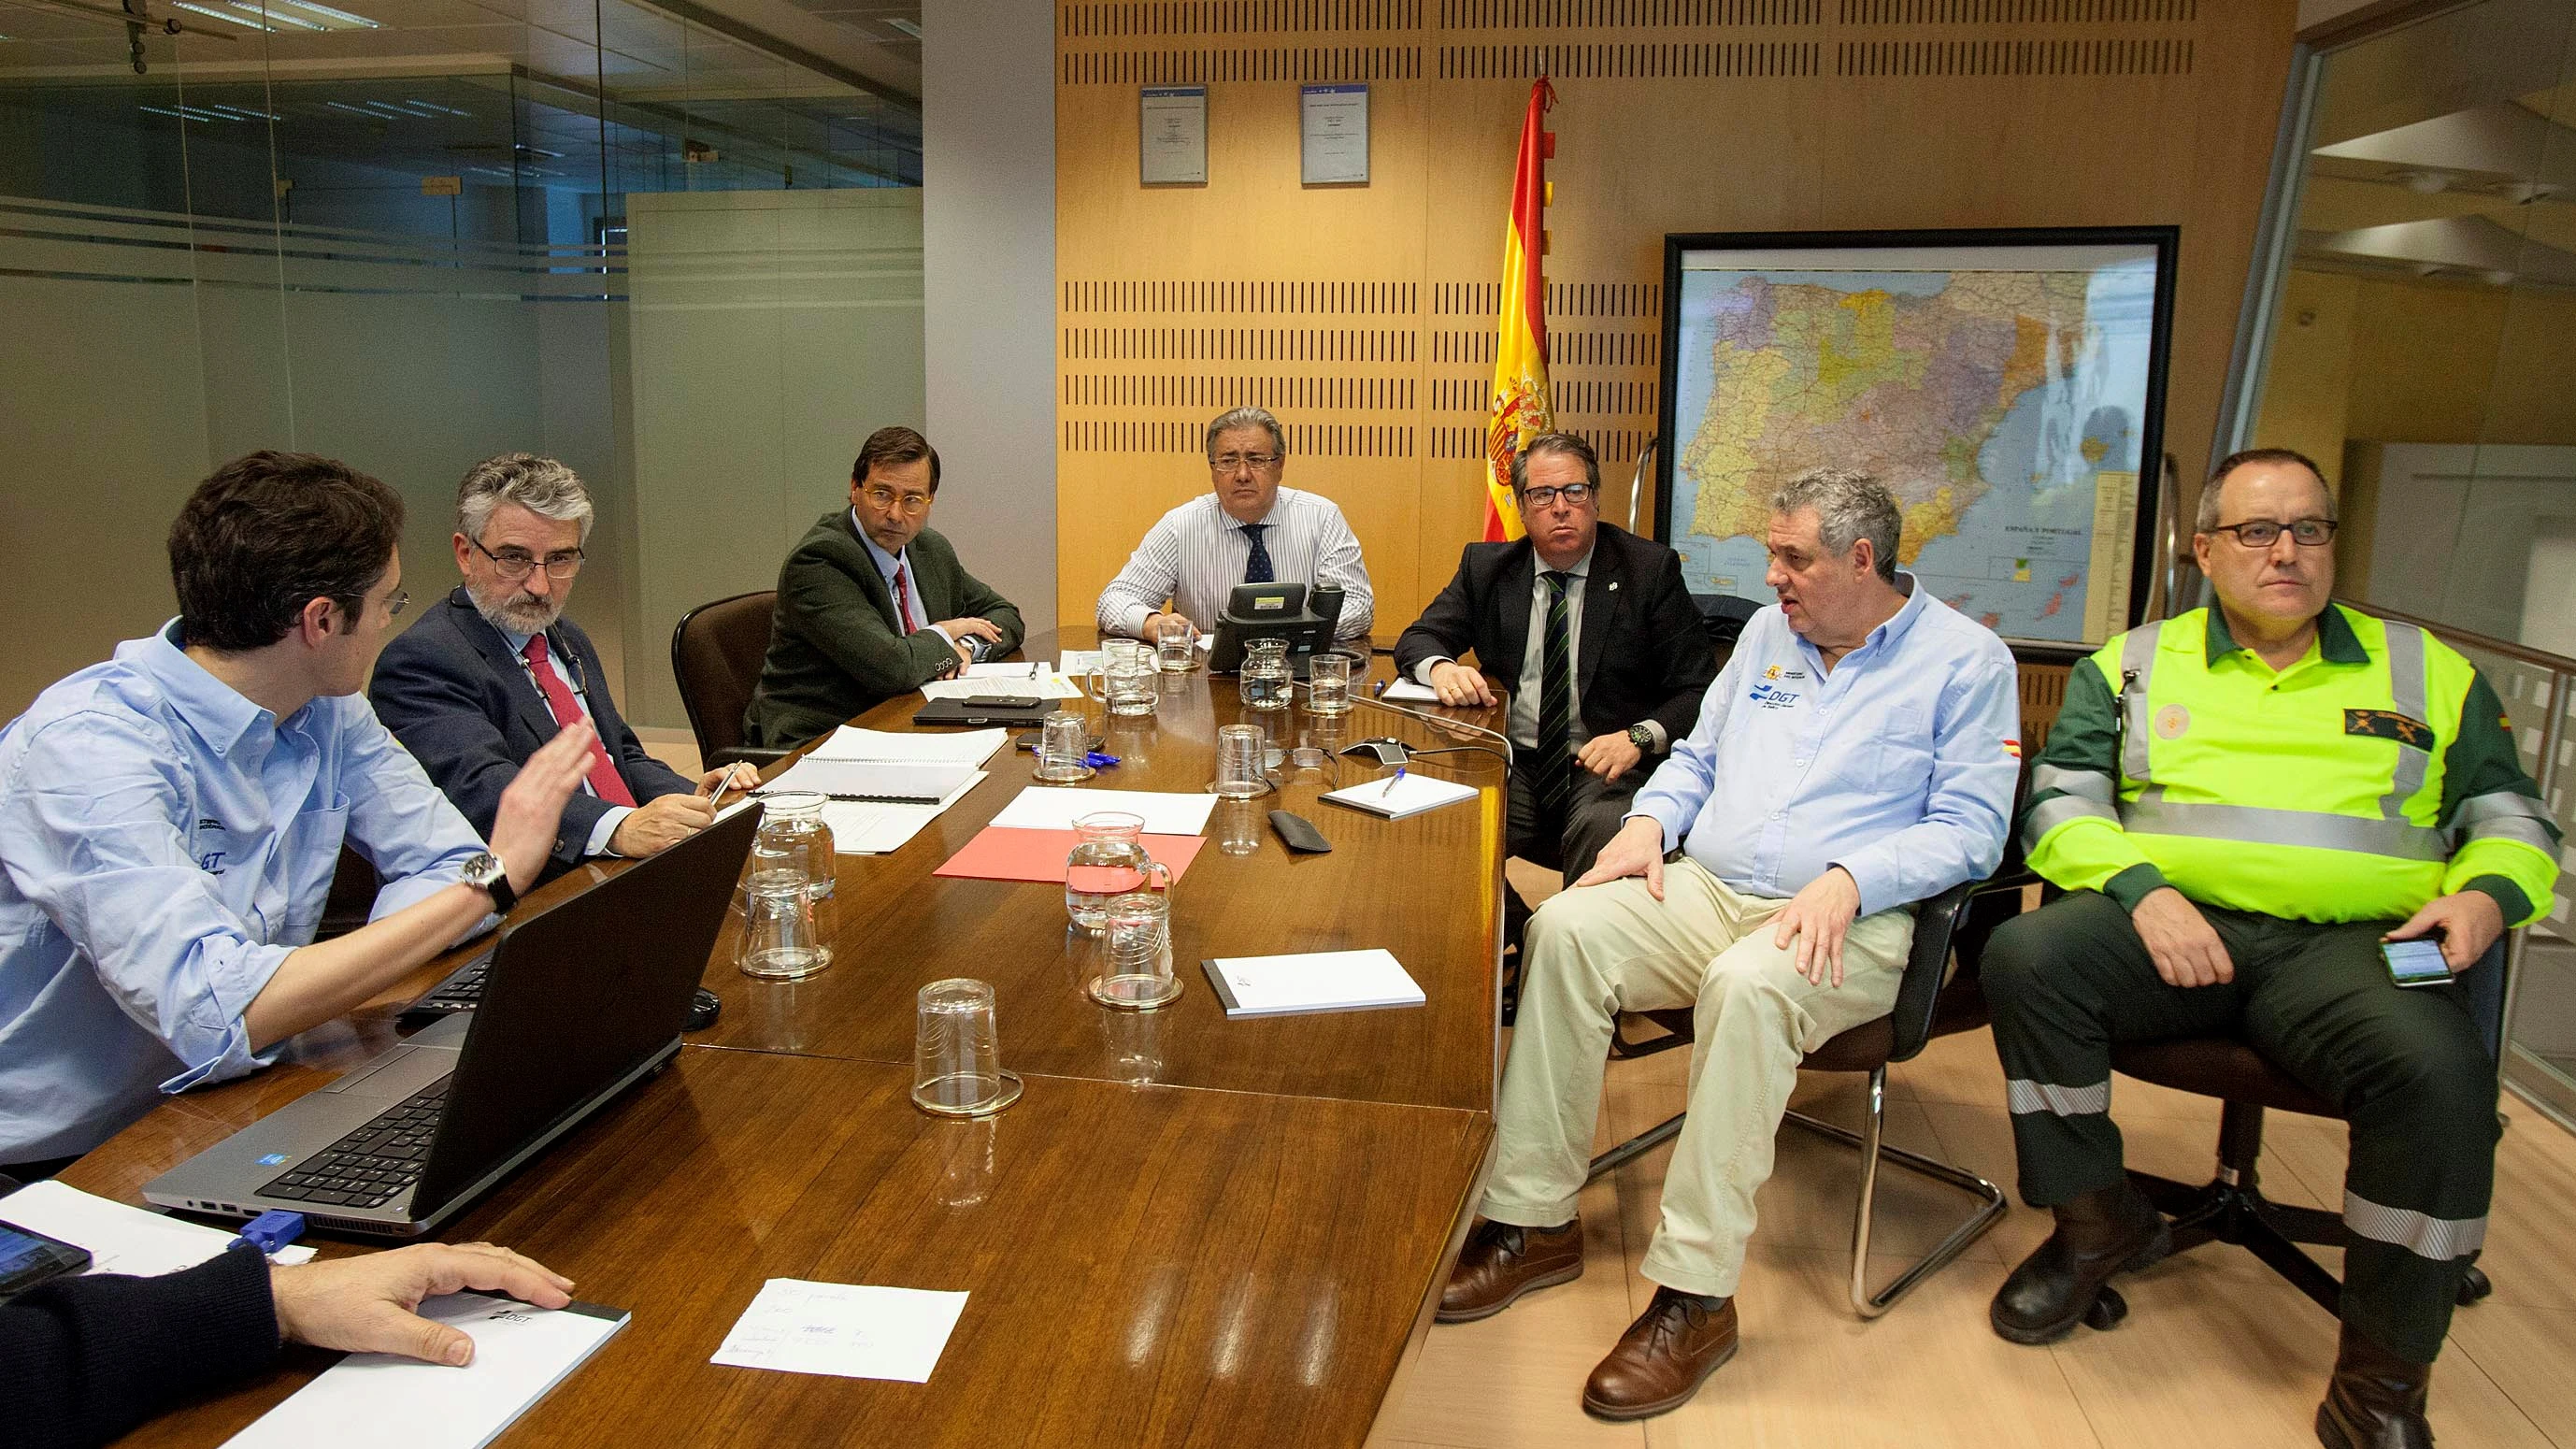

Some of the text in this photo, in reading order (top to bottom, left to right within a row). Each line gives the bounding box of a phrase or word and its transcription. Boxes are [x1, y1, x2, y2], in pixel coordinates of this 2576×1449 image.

[1768, 690, 1800, 704] DGT
[201, 852, 226, 870] GT
[506, 1313, 533, 1324] DGT
